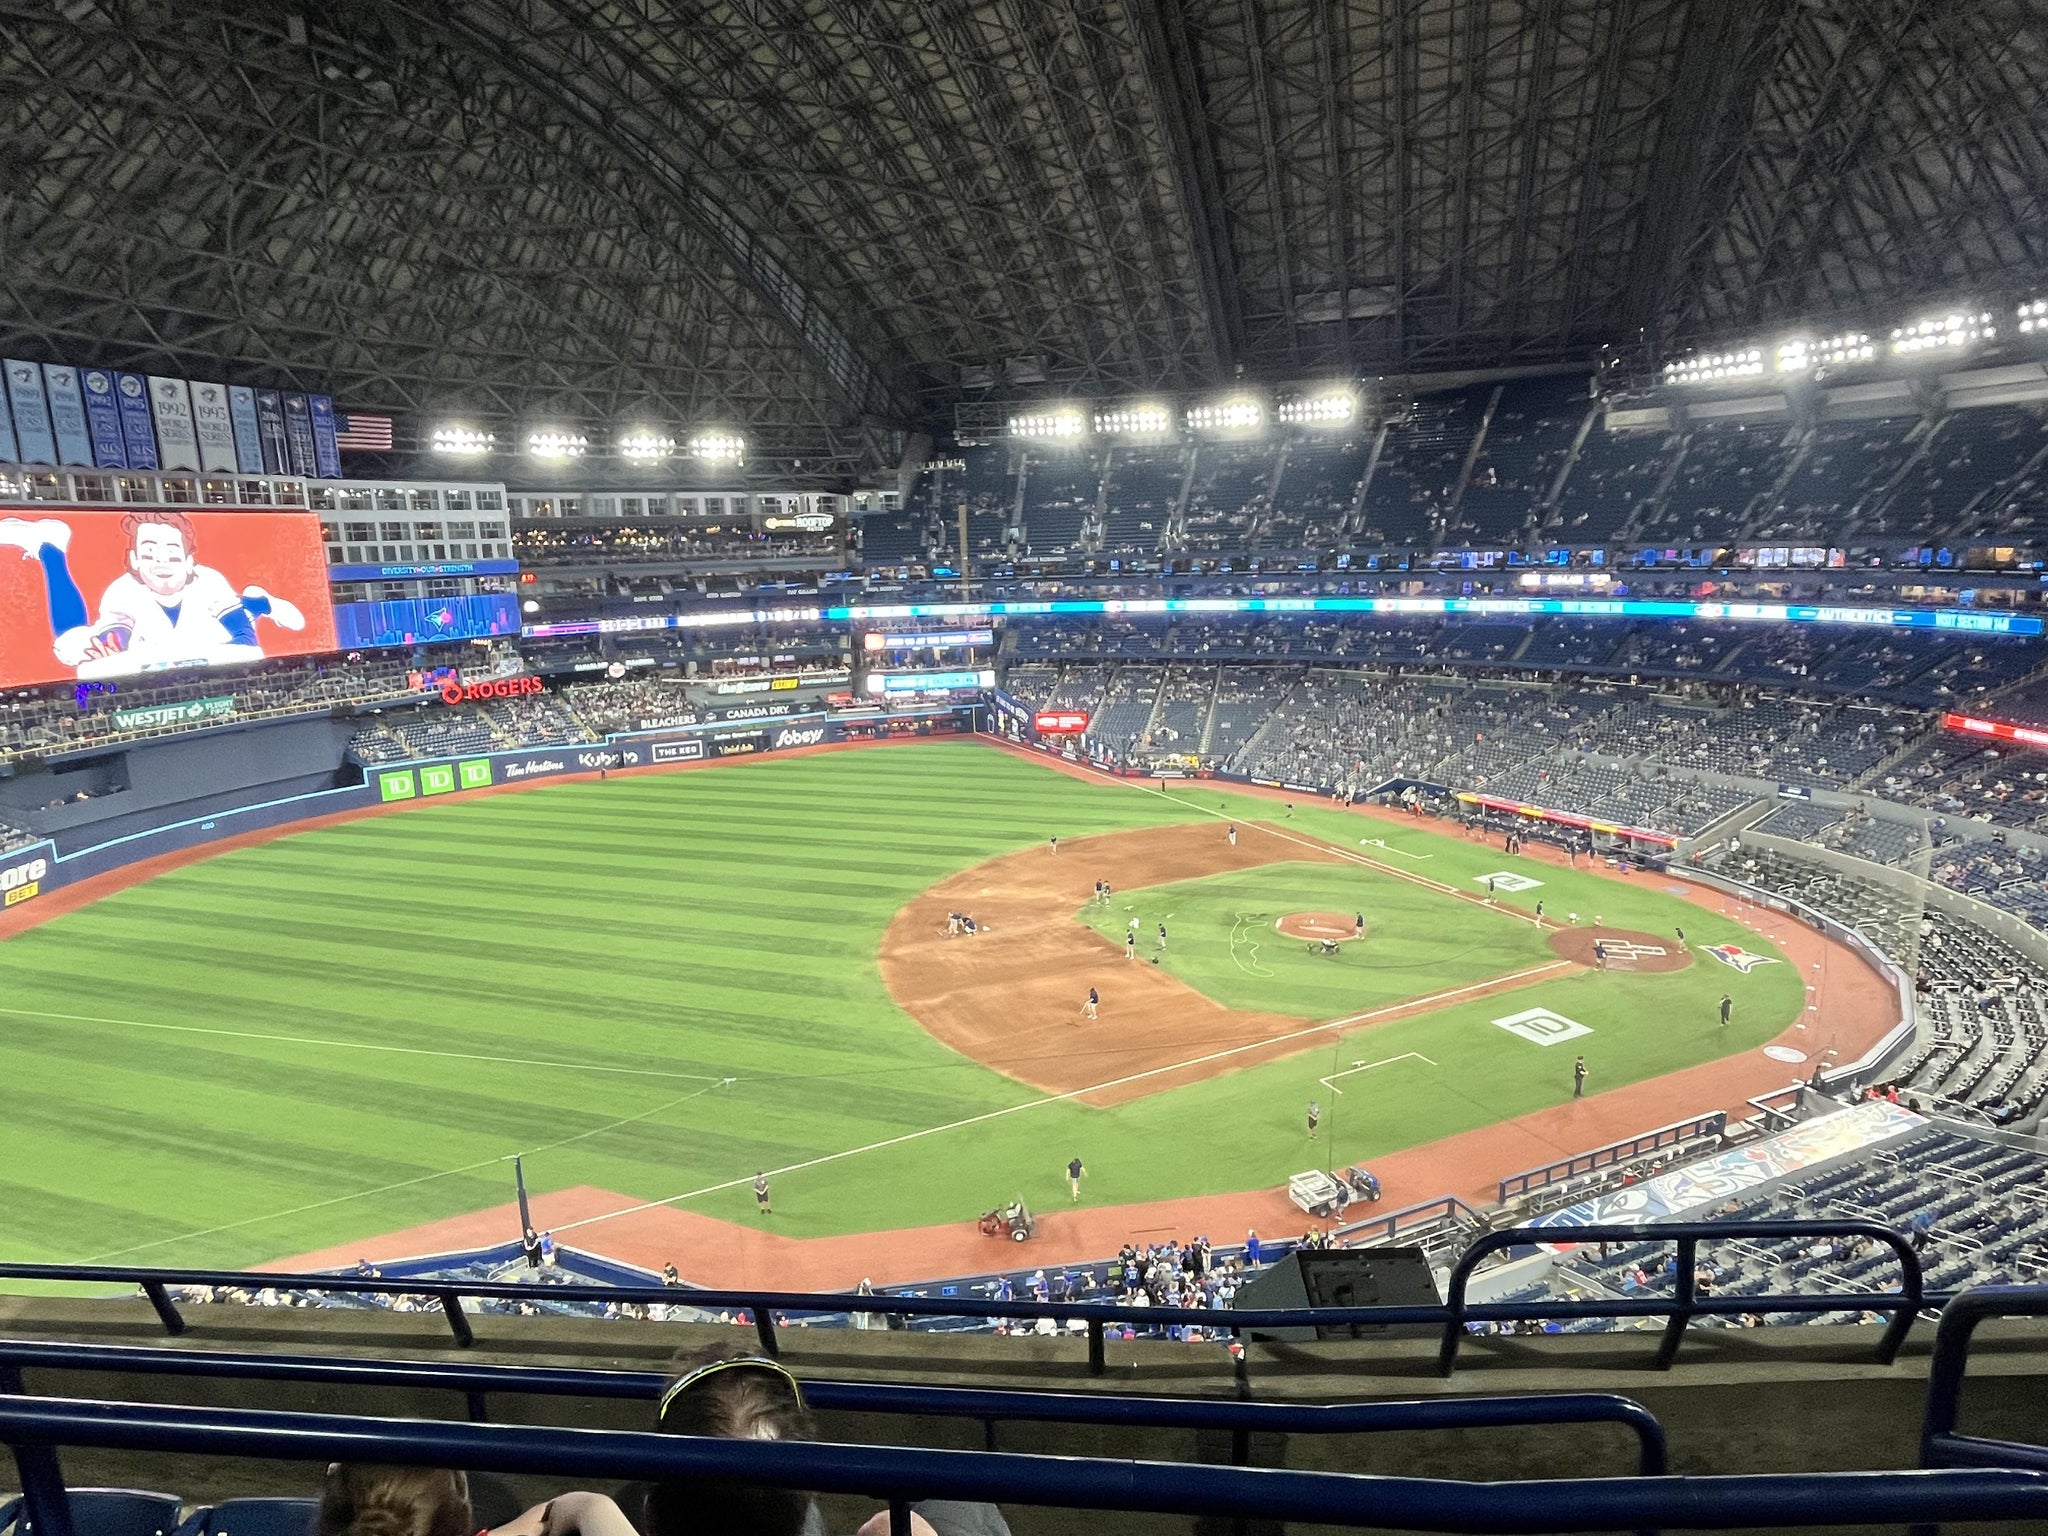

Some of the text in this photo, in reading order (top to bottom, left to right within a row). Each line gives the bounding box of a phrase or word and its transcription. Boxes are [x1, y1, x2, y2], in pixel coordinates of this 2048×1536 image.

[157, 401, 189, 417] 1992
[198, 405, 227, 420] 1993
[381, 566, 418, 575] DIVERSITY
[439, 564, 474, 574] STRENGTH
[1816, 607, 1894, 624] AUTHENTICS
[1936, 613, 1956, 627] VISIT
[1957, 615, 1993, 630] SECTION
[467, 676, 544, 700] ROGERS
[115, 699, 234, 728] WESTJET FLIGHT
[726, 705, 790, 719] CANADA DRY
[640, 714, 697, 729] BLEACHERS
[775, 728, 824, 748] Sobeys
[658, 745, 698, 756] THE KEG
[462, 765, 489, 783] TD
[504, 760, 565, 778] Tim Hortons
[384, 777, 411, 795] TD
[424, 771, 450, 789] TD
[8, 884, 37, 902] BET
[1508, 1016, 1571, 1036] TD
